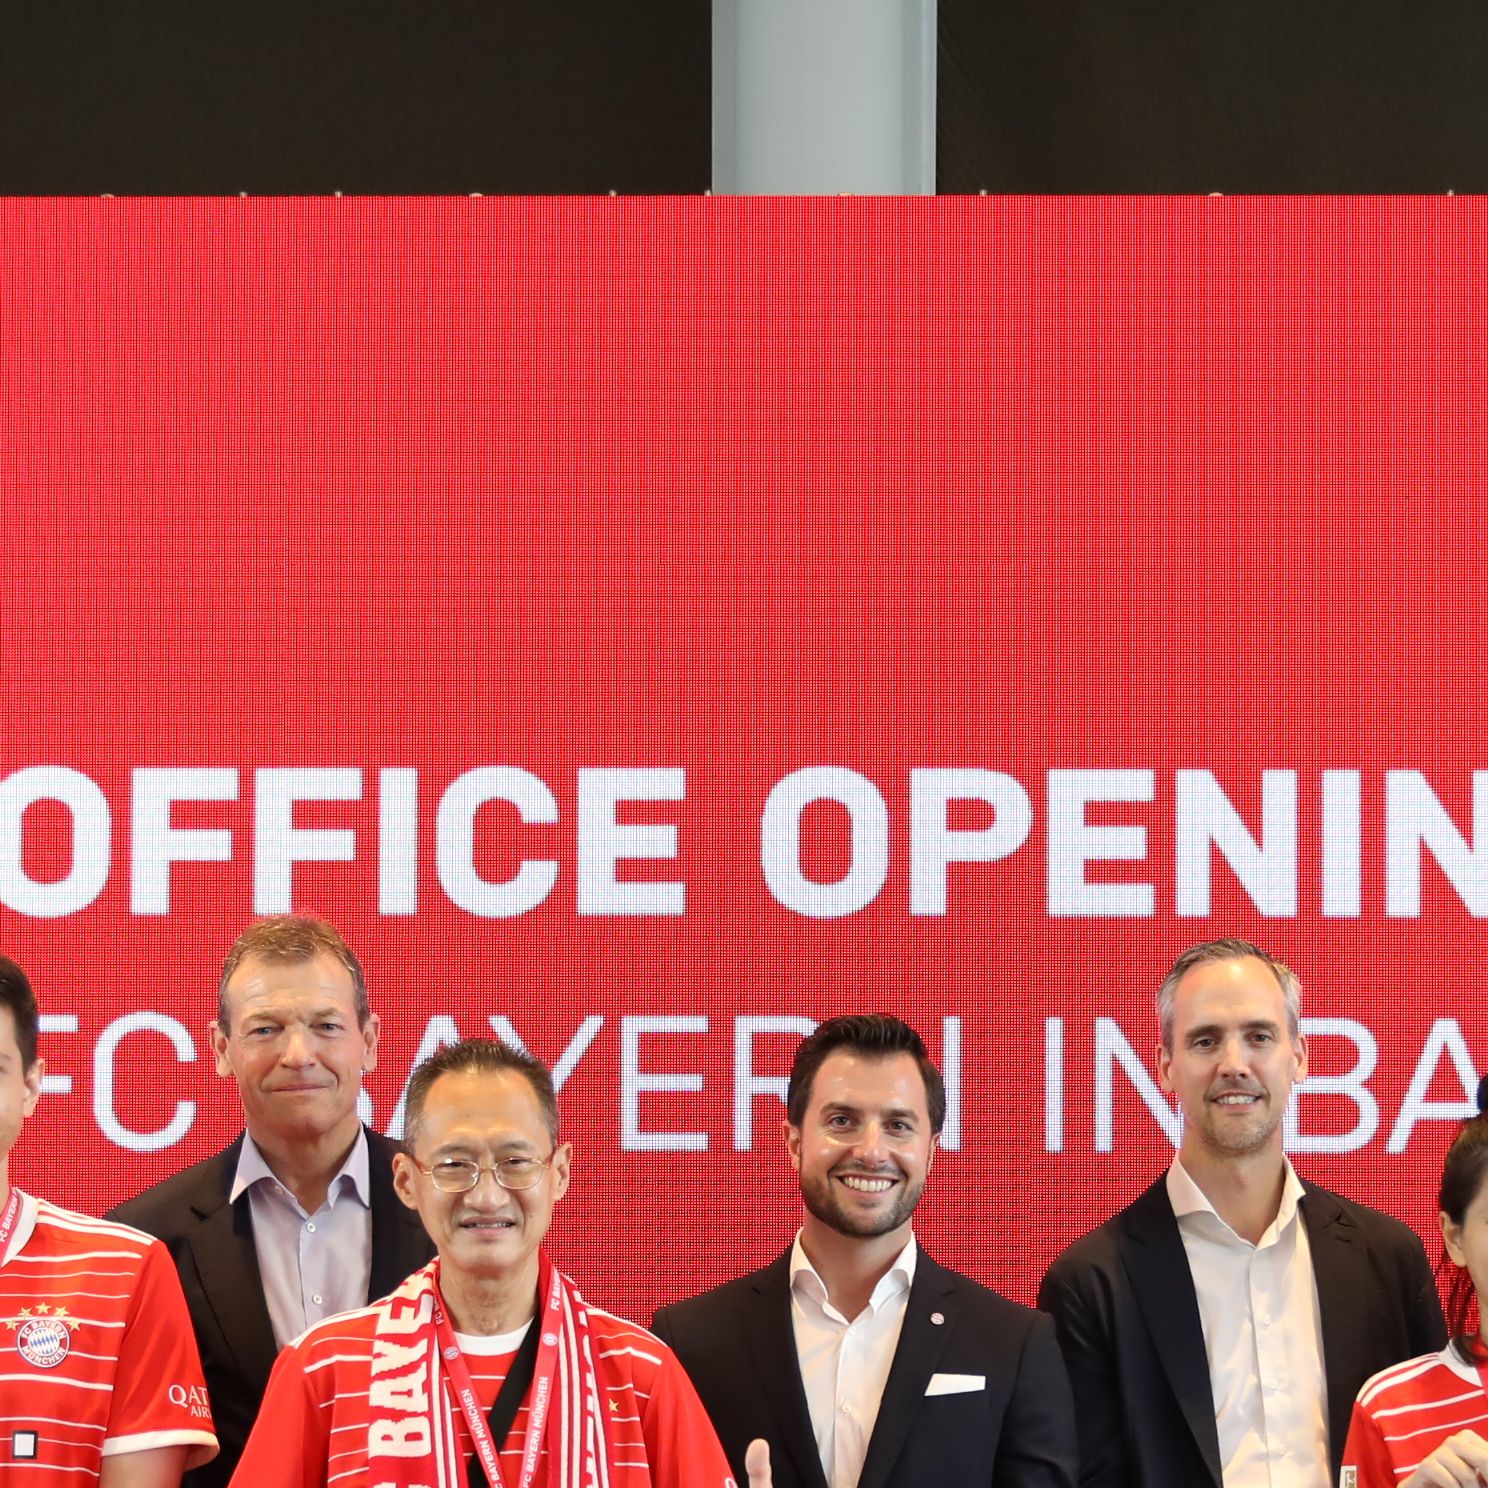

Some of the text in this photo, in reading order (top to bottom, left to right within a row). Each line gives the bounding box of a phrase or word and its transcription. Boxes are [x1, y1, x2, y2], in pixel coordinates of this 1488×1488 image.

[1045, 1016, 1185, 1153] IN
[168, 1383, 208, 1408] QAT
[461, 1388, 488, 1441] MÜNCHEN
[522, 1376, 549, 1488] FC BAYERN MÜNCHEN
[478, 1438, 501, 1482] BAYERN
